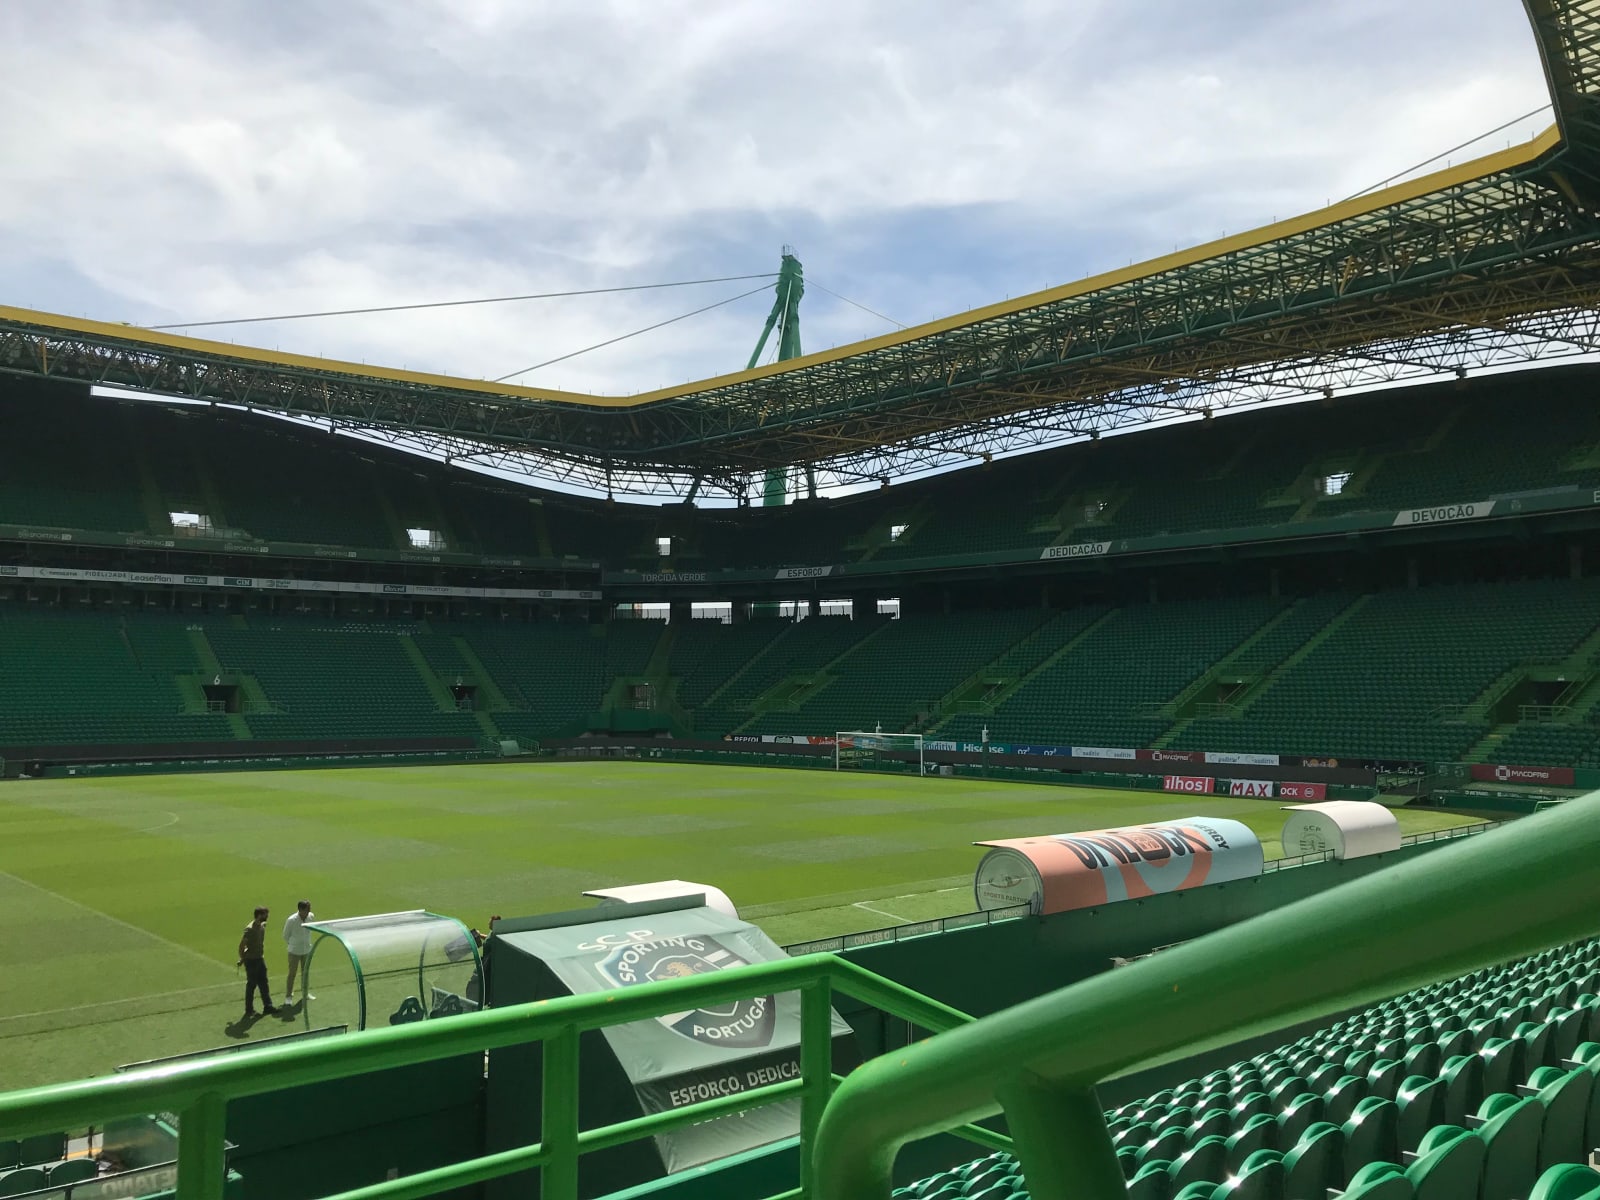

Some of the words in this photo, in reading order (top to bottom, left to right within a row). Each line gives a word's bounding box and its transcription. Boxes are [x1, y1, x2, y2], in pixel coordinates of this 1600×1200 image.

[130, 574, 172, 583] LeasePlan
[641, 574, 677, 582] TORCIDA
[678, 573, 706, 582] VERDE
[213, 674, 221, 685] 6
[1231, 783, 1269, 797] MAX
[1189, 824, 1230, 849] NERGY
[577, 929, 654, 951] SCP
[618, 937, 705, 982] SPORTING
[693, 995, 768, 1039] PORTUGA
